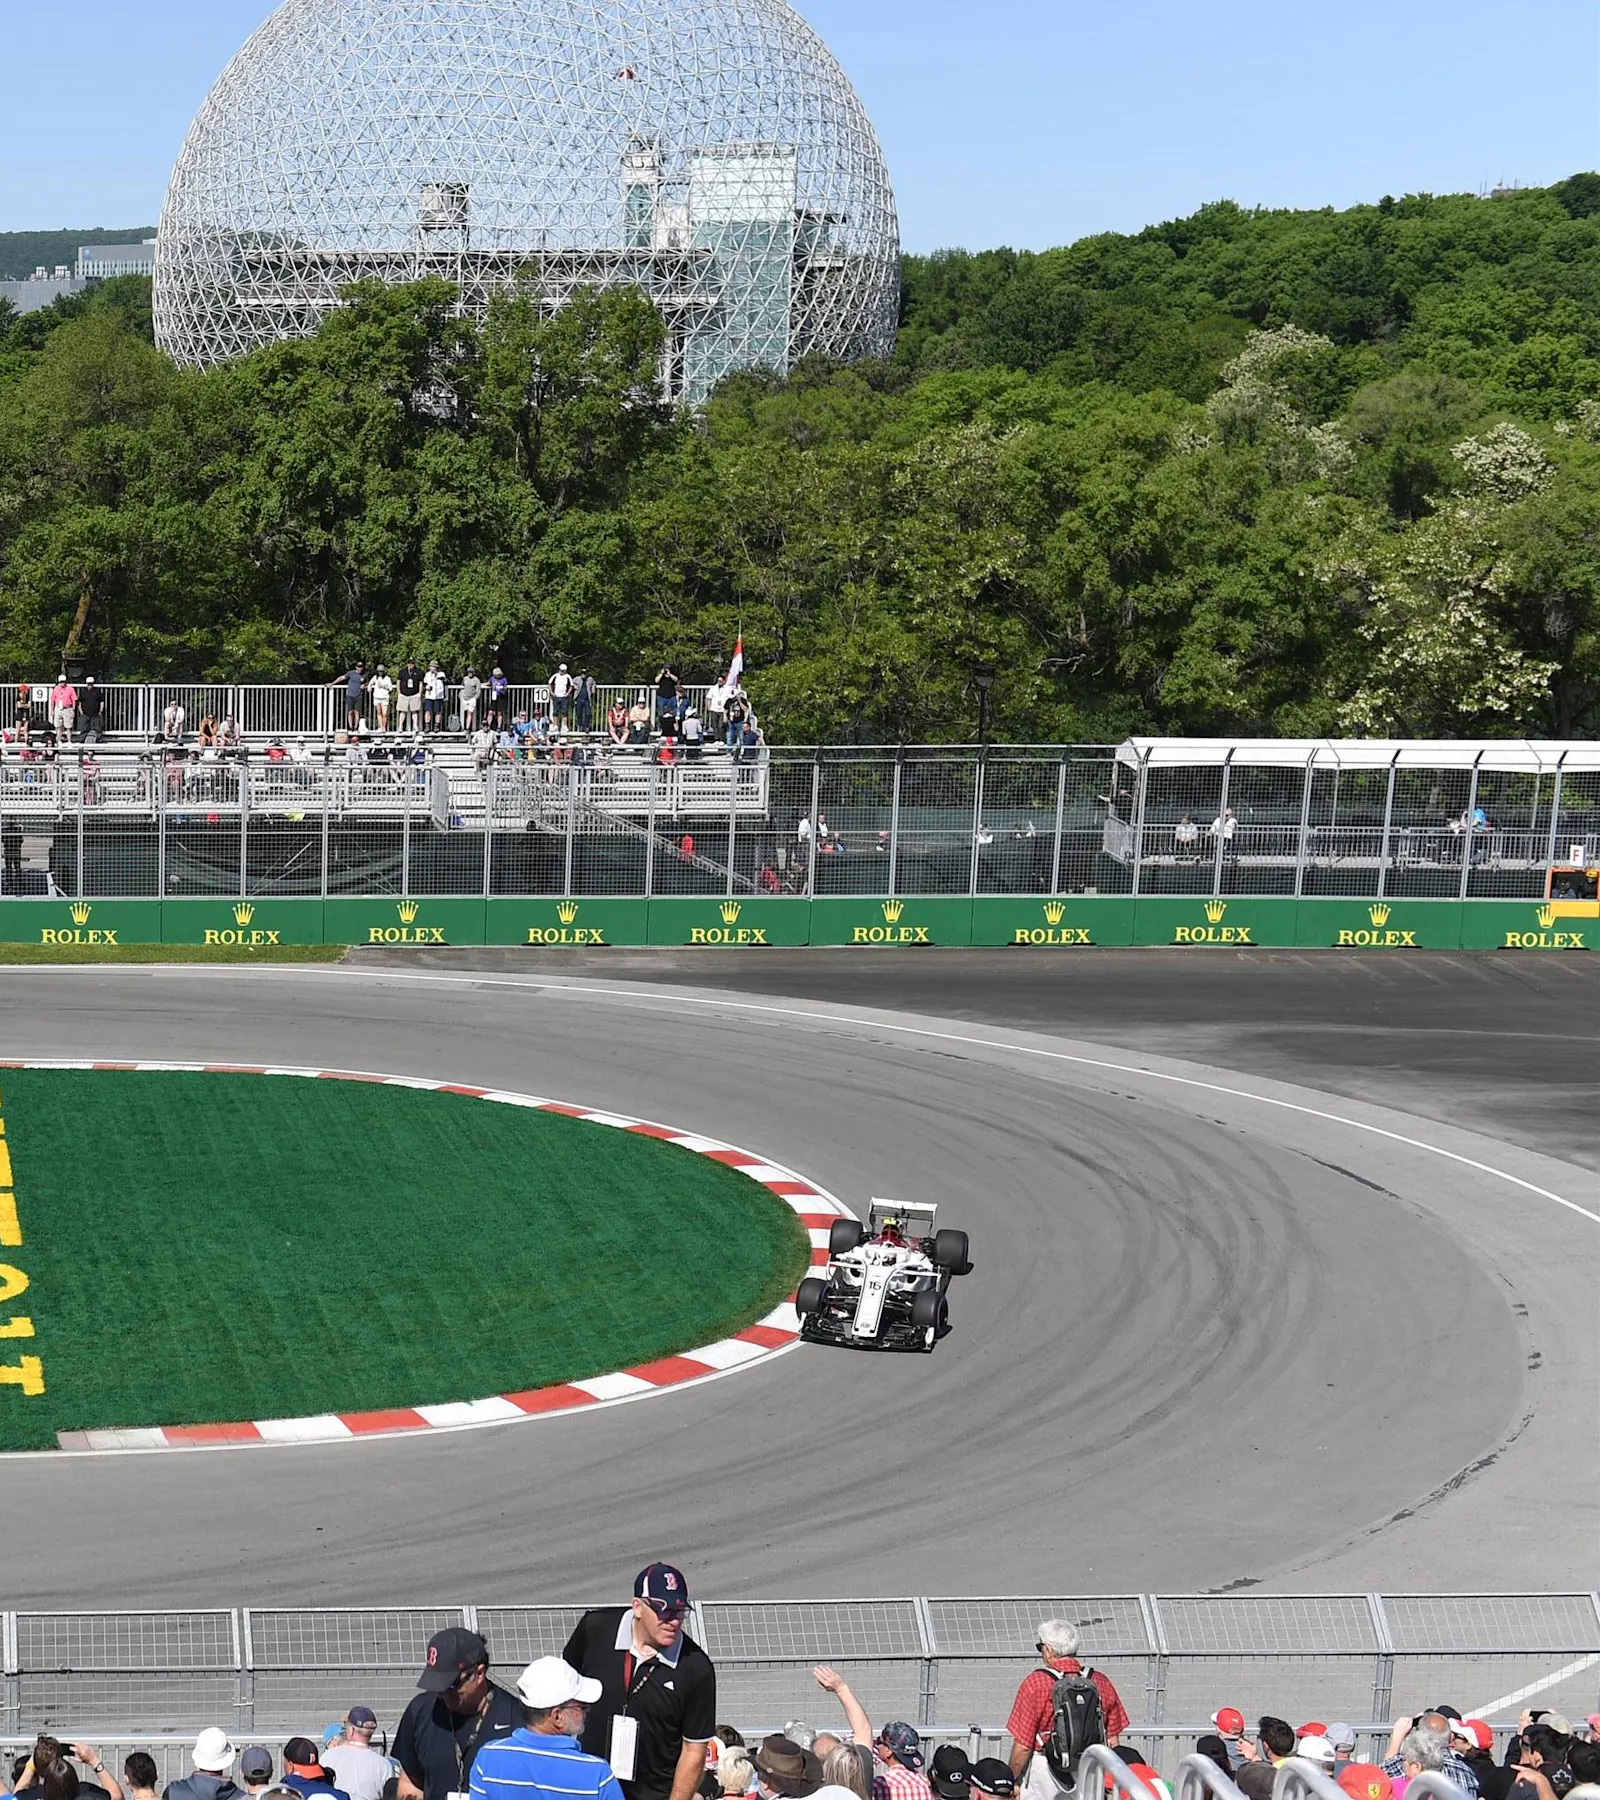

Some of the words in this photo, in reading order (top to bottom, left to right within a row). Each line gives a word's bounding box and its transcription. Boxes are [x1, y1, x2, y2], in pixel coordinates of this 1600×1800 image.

[36, 689, 43, 699] 9
[536, 689, 548, 701] 10
[1573, 849, 1580, 862] F
[41, 929, 118, 945] ROLEX
[203, 931, 279, 947] ROLEX
[368, 927, 444, 943] ROLEX
[528, 928, 603, 944] ROLEX
[690, 928, 765, 944] ROLEX
[853, 927, 928, 943] ROLEX
[1014, 928, 1090, 944] ROLEX
[1175, 927, 1250, 943] ROLEX
[1338, 930, 1415, 946] ROLEX
[1505, 933, 1582, 949] ROLEX
